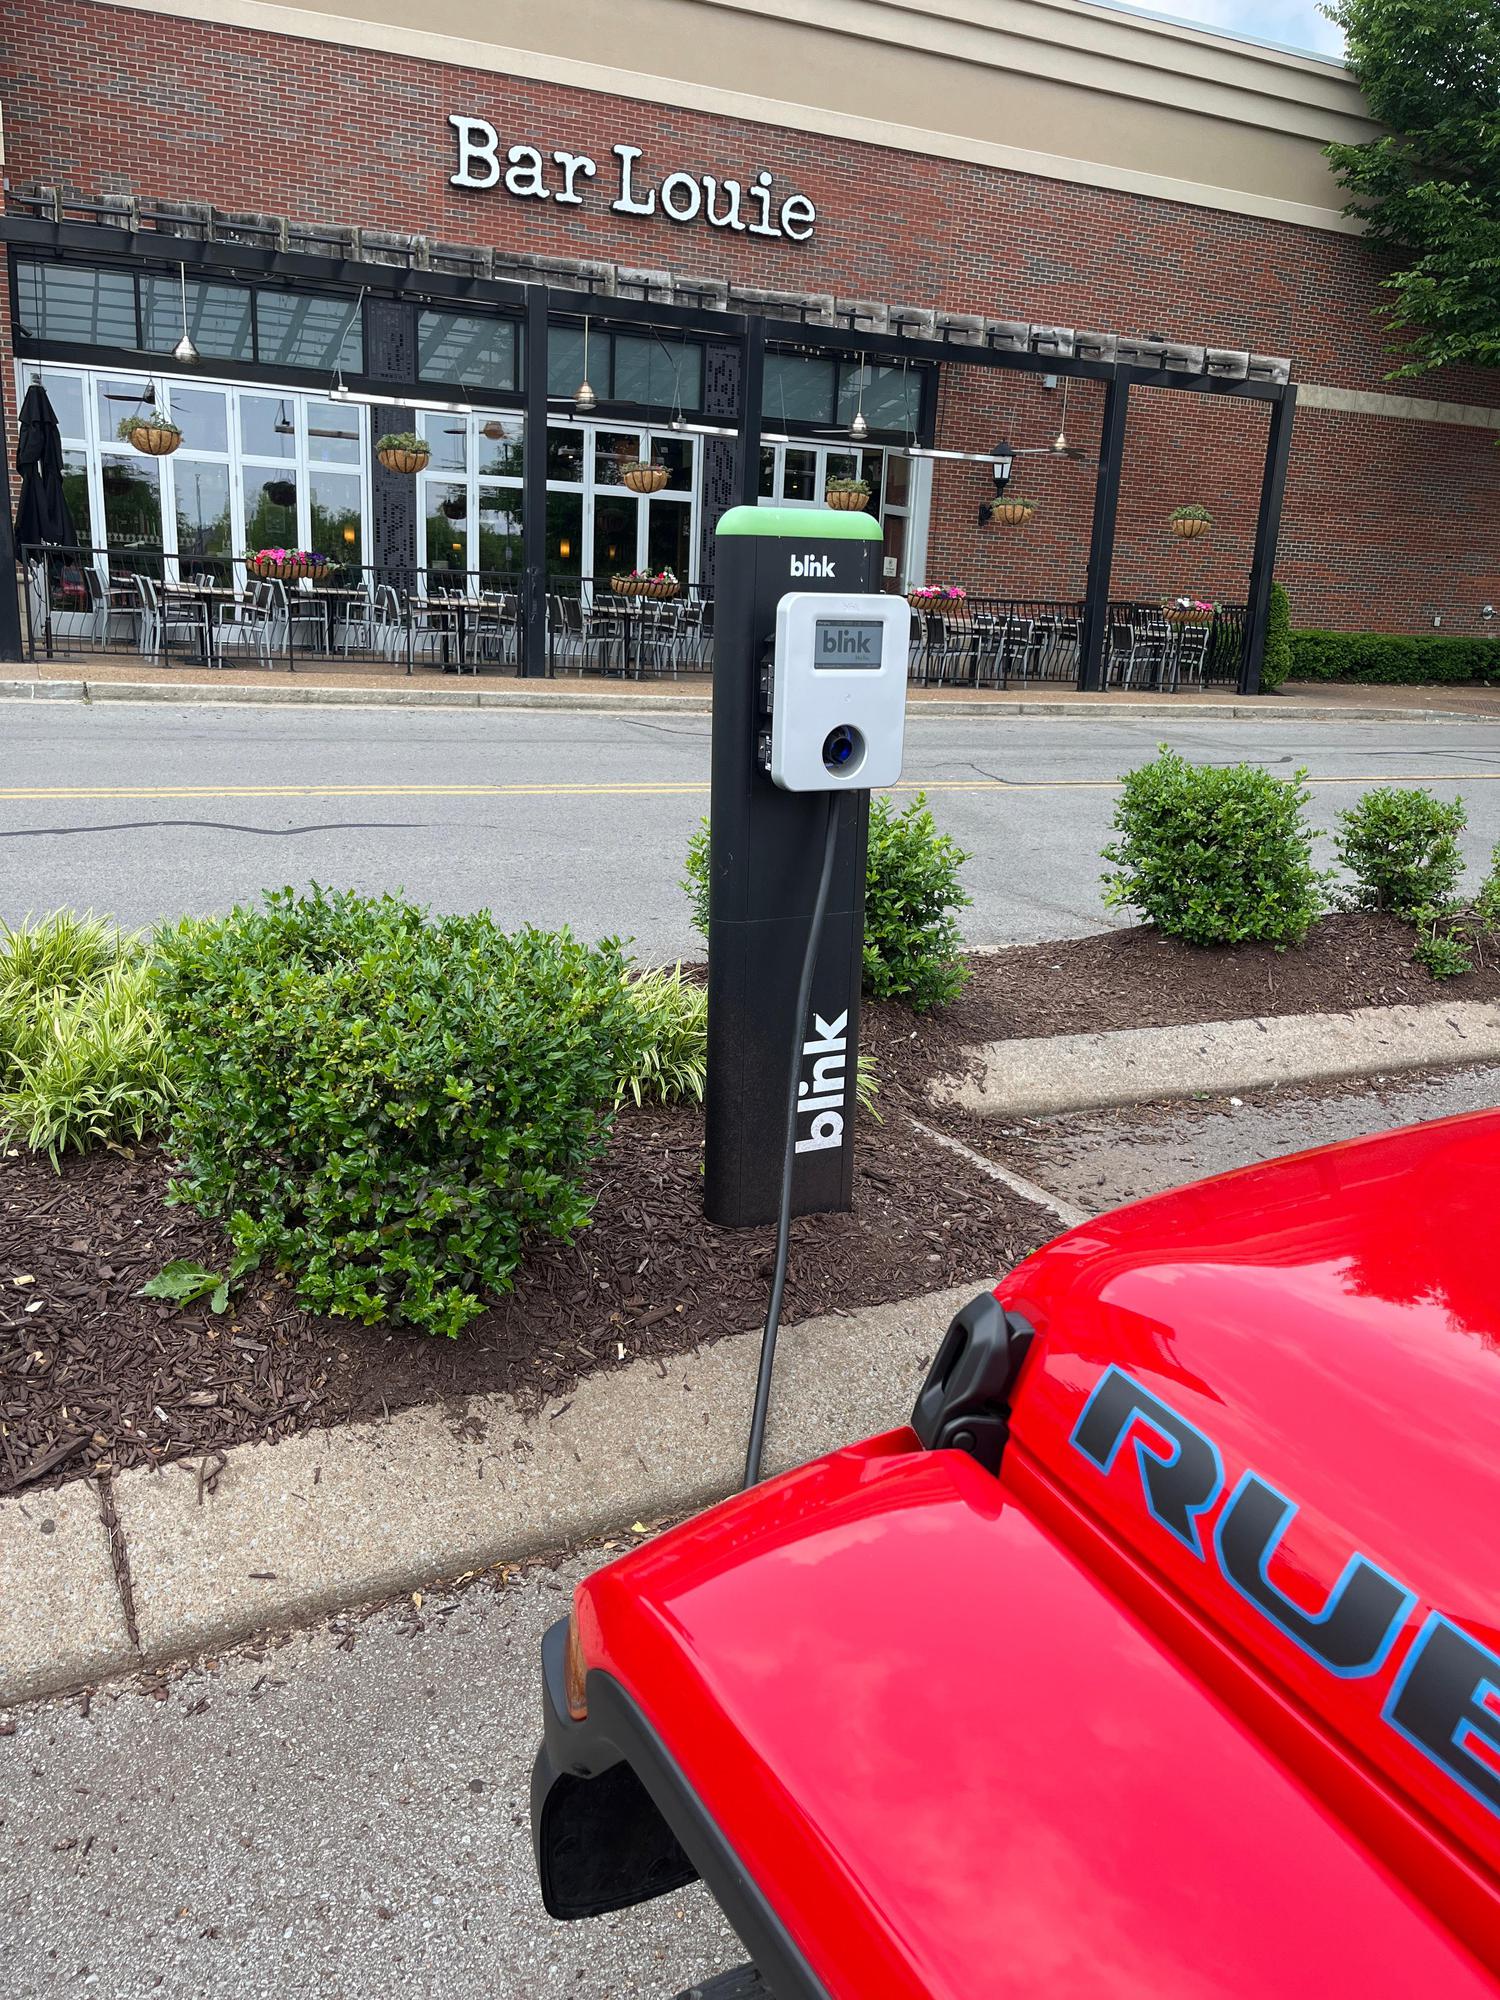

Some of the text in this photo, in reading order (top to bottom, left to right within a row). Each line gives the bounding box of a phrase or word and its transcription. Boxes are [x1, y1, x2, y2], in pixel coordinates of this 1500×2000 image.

[447, 114, 817, 241] Bar Louie
[790, 553, 836, 578] blink
[823, 630, 871, 654] blink
[795, 1009, 848, 1154] blink
